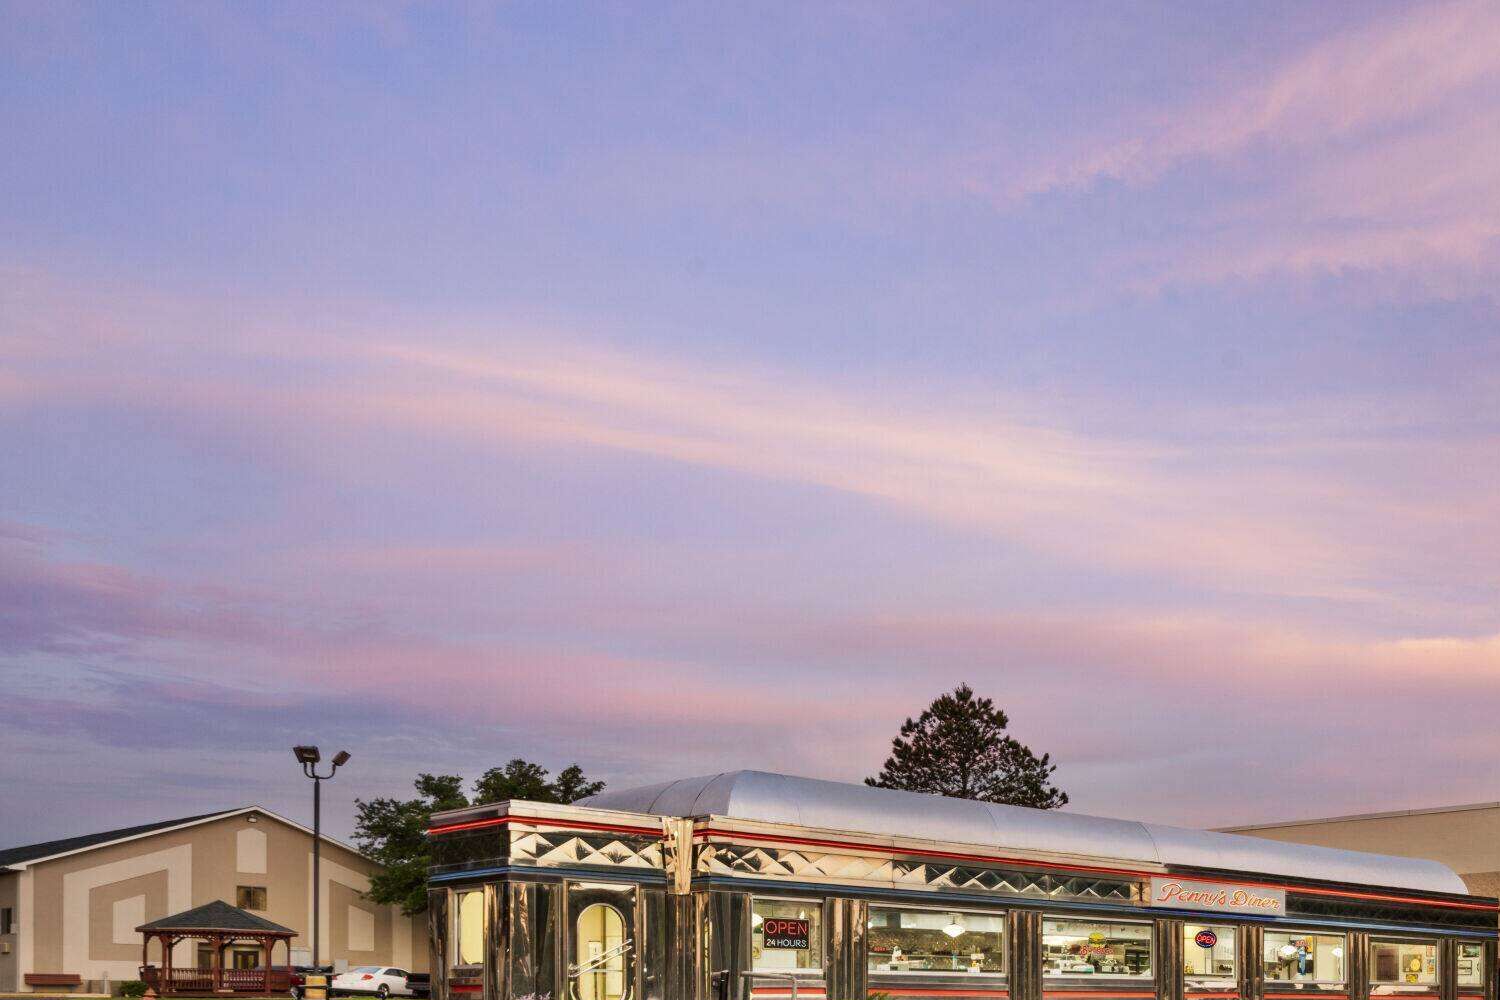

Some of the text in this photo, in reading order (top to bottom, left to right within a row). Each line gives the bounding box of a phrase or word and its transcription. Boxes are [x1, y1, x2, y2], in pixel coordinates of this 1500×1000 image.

[1157, 880, 1280, 911] Penny's Diner
[765, 920, 808, 936] OPEN
[766, 938, 807, 948] 24 HOURS
[1196, 933, 1216, 945] OPEN
